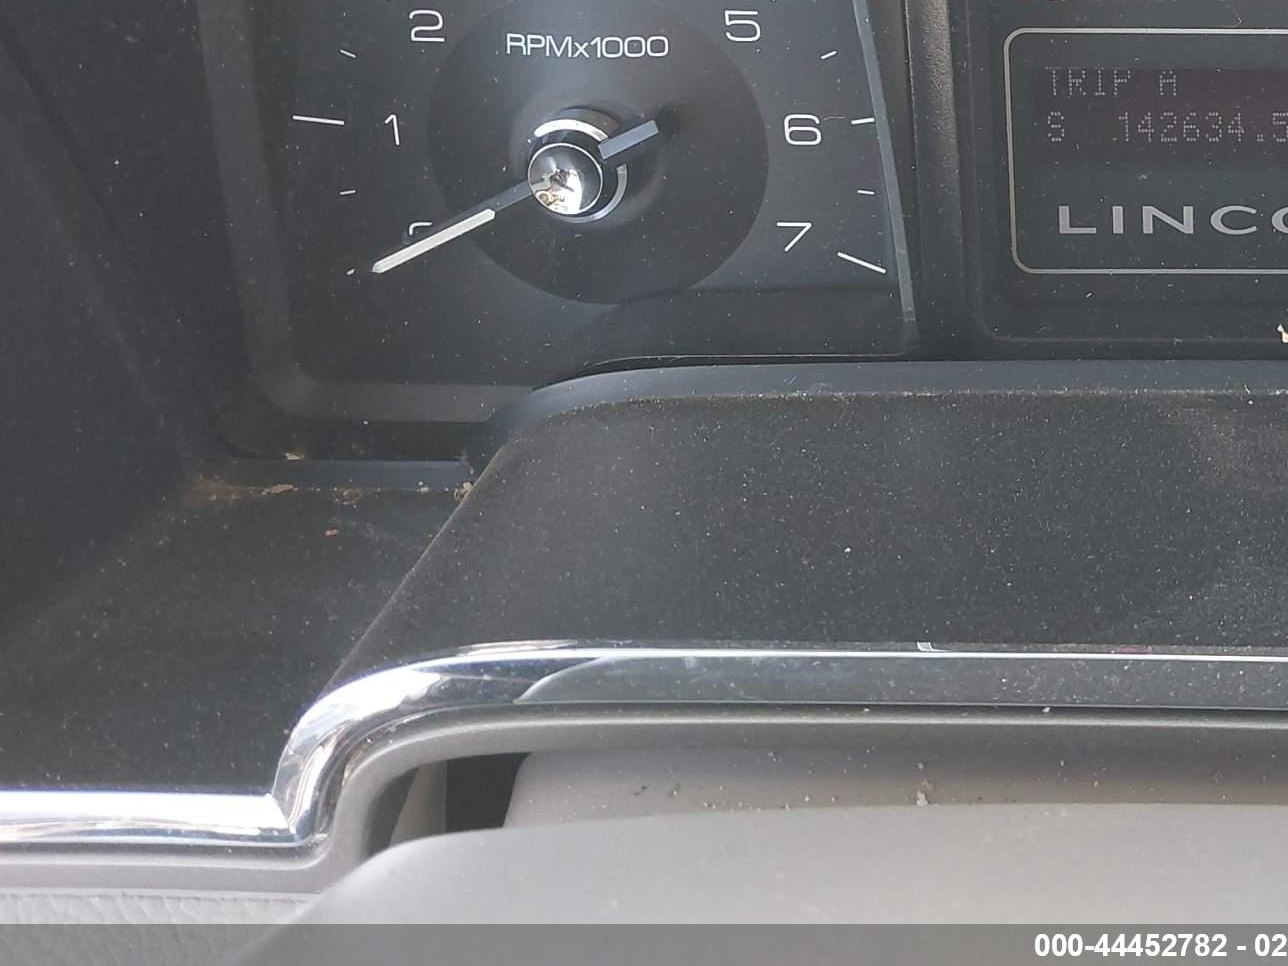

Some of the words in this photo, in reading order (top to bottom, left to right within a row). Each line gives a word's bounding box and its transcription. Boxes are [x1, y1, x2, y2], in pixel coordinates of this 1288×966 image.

[409, 9, 445, 42] 2
[725, 10, 761, 42] 5
[506, 33, 670, 59] RPMx1000
[1045, 66, 1132, 97] TRIP
[1158, 68, 1178, 97] A
[384, 114, 401, 146] 1
[783, 114, 822, 146] 6
[777, 222, 813, 252] 7
